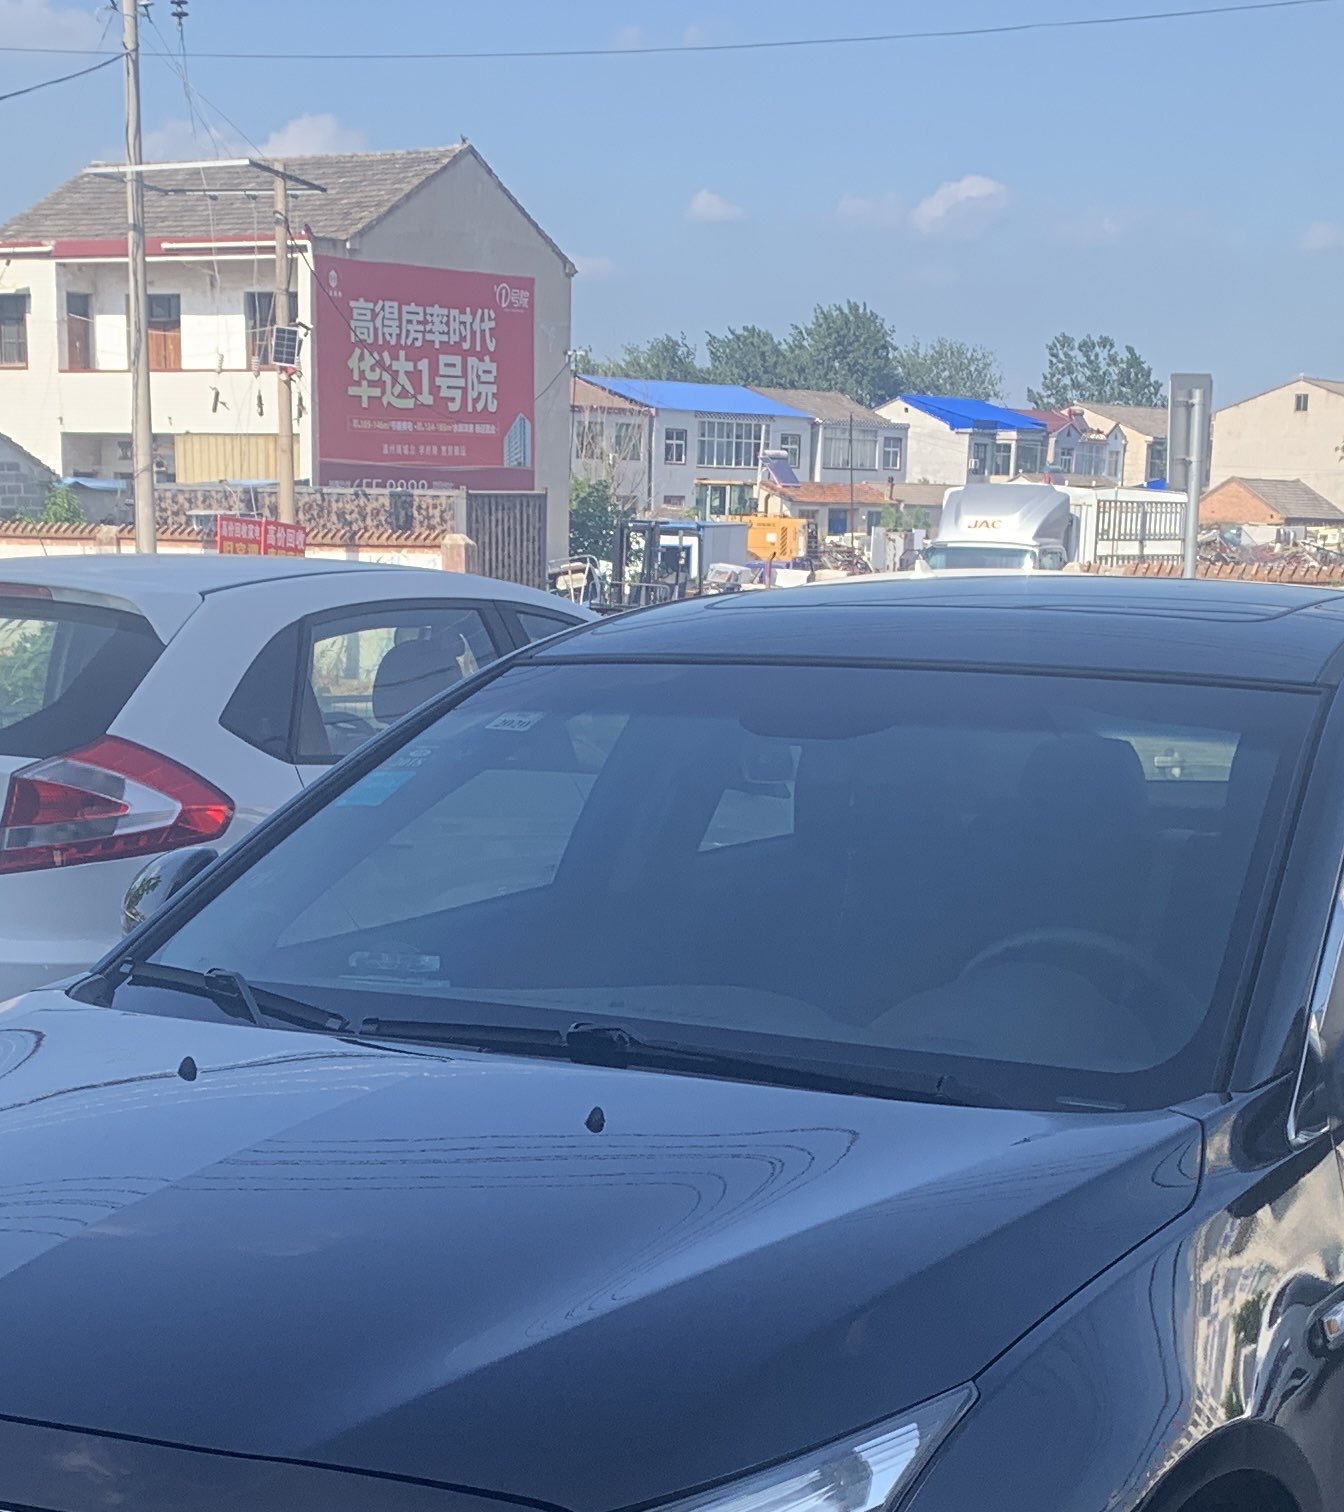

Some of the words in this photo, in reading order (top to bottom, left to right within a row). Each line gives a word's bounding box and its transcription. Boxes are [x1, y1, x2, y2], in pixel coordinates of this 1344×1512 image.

[349, 298, 496, 352] 高得房率时代
[347, 347, 498, 413] 华达1号院
[267, 525, 305, 549] 高价回收
[968, 520, 1002, 529] JAC
